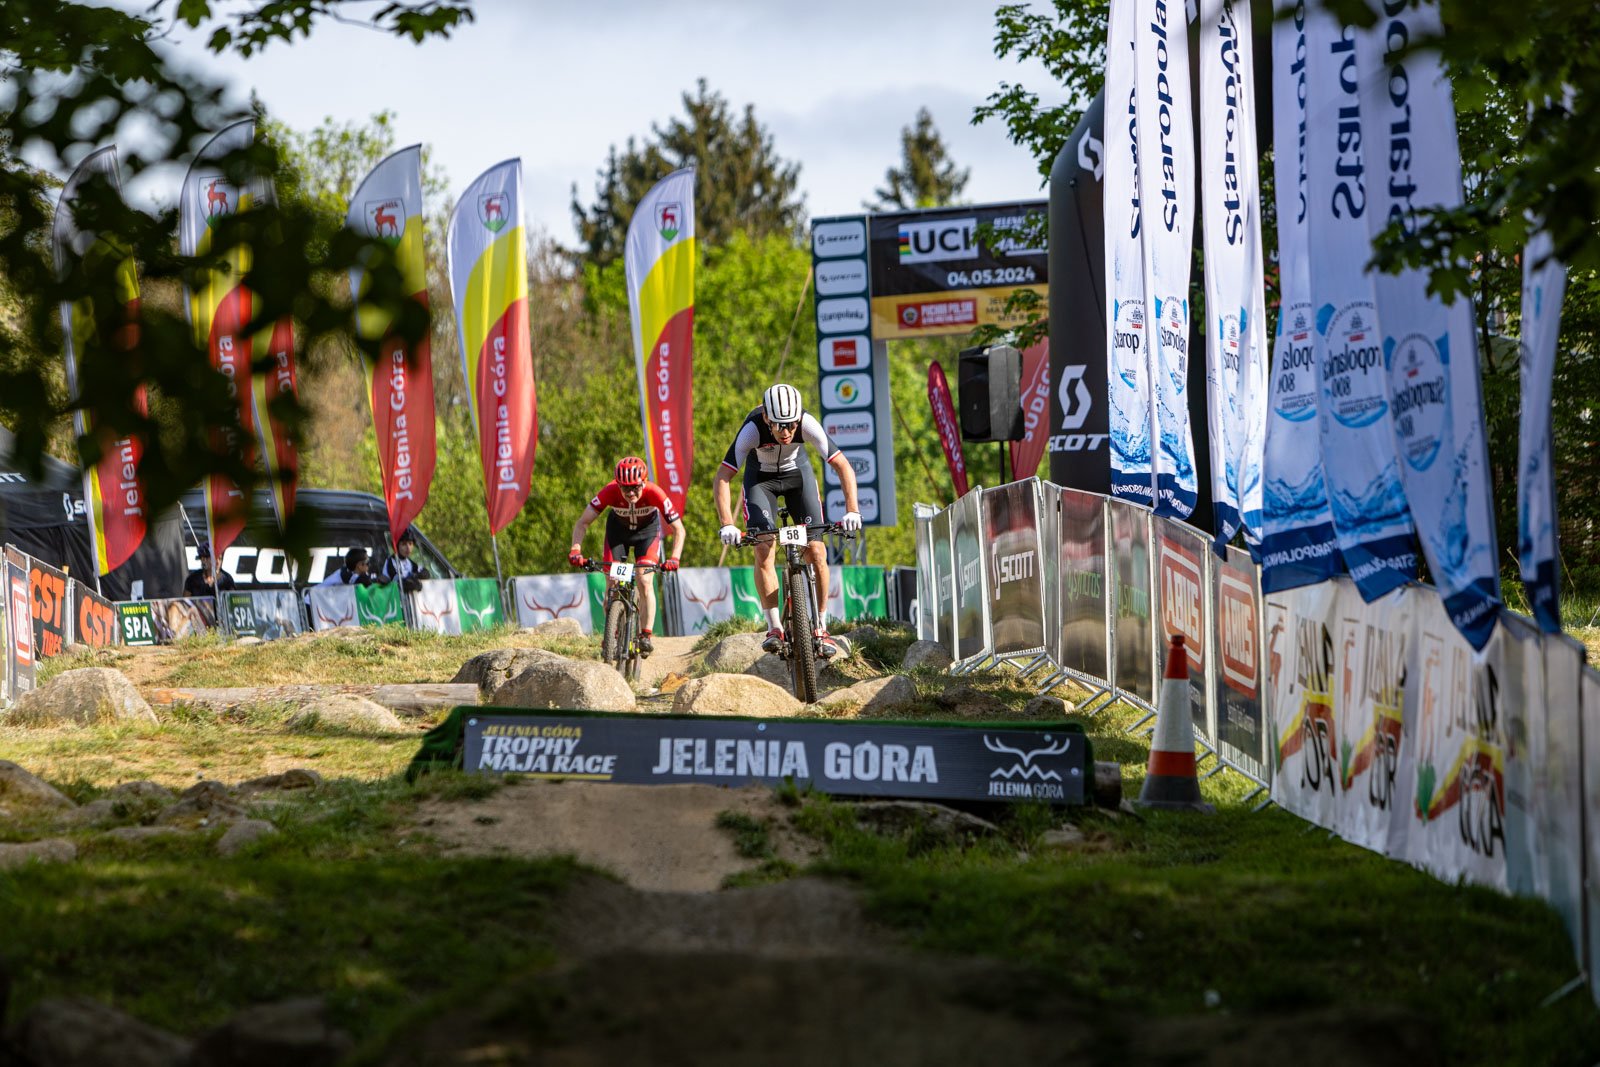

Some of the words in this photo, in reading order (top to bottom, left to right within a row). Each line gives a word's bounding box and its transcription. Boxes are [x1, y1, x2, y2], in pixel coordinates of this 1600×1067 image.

[913, 226, 971, 254] UCI
[947, 267, 1036, 286] 04.05.2024
[390, 349, 405, 411] Góra
[488, 335, 506, 396] Góra
[658, 342, 670, 402] Góra
[393, 415, 413, 501] Jelenia
[496, 405, 520, 492] Jelenia
[658, 409, 683, 494] Jelenia
[114, 438, 143, 517] Jeleni
[786, 529, 800, 540] 58
[616, 565, 627, 576] 62
[1001, 550, 1034, 584] SCOTT
[30, 568, 65, 629] CST
[79, 595, 114, 649] CST
[234, 606, 255, 628] SPA
[1166, 566, 1200, 644] ABUS
[124, 616, 152, 639] SPA
[1225, 595, 1254, 668] ABUS
[481, 725, 539, 737] JELENIA
[542, 724, 582, 738] GÓRA
[481, 736, 580, 755] TROPHY
[479, 753, 549, 772] MAJA
[552, 755, 617, 773] RACE
[652, 737, 810, 779] JELENIA
[824, 740, 939, 784] GÓRA
[988, 781, 1032, 798] JELENIA
